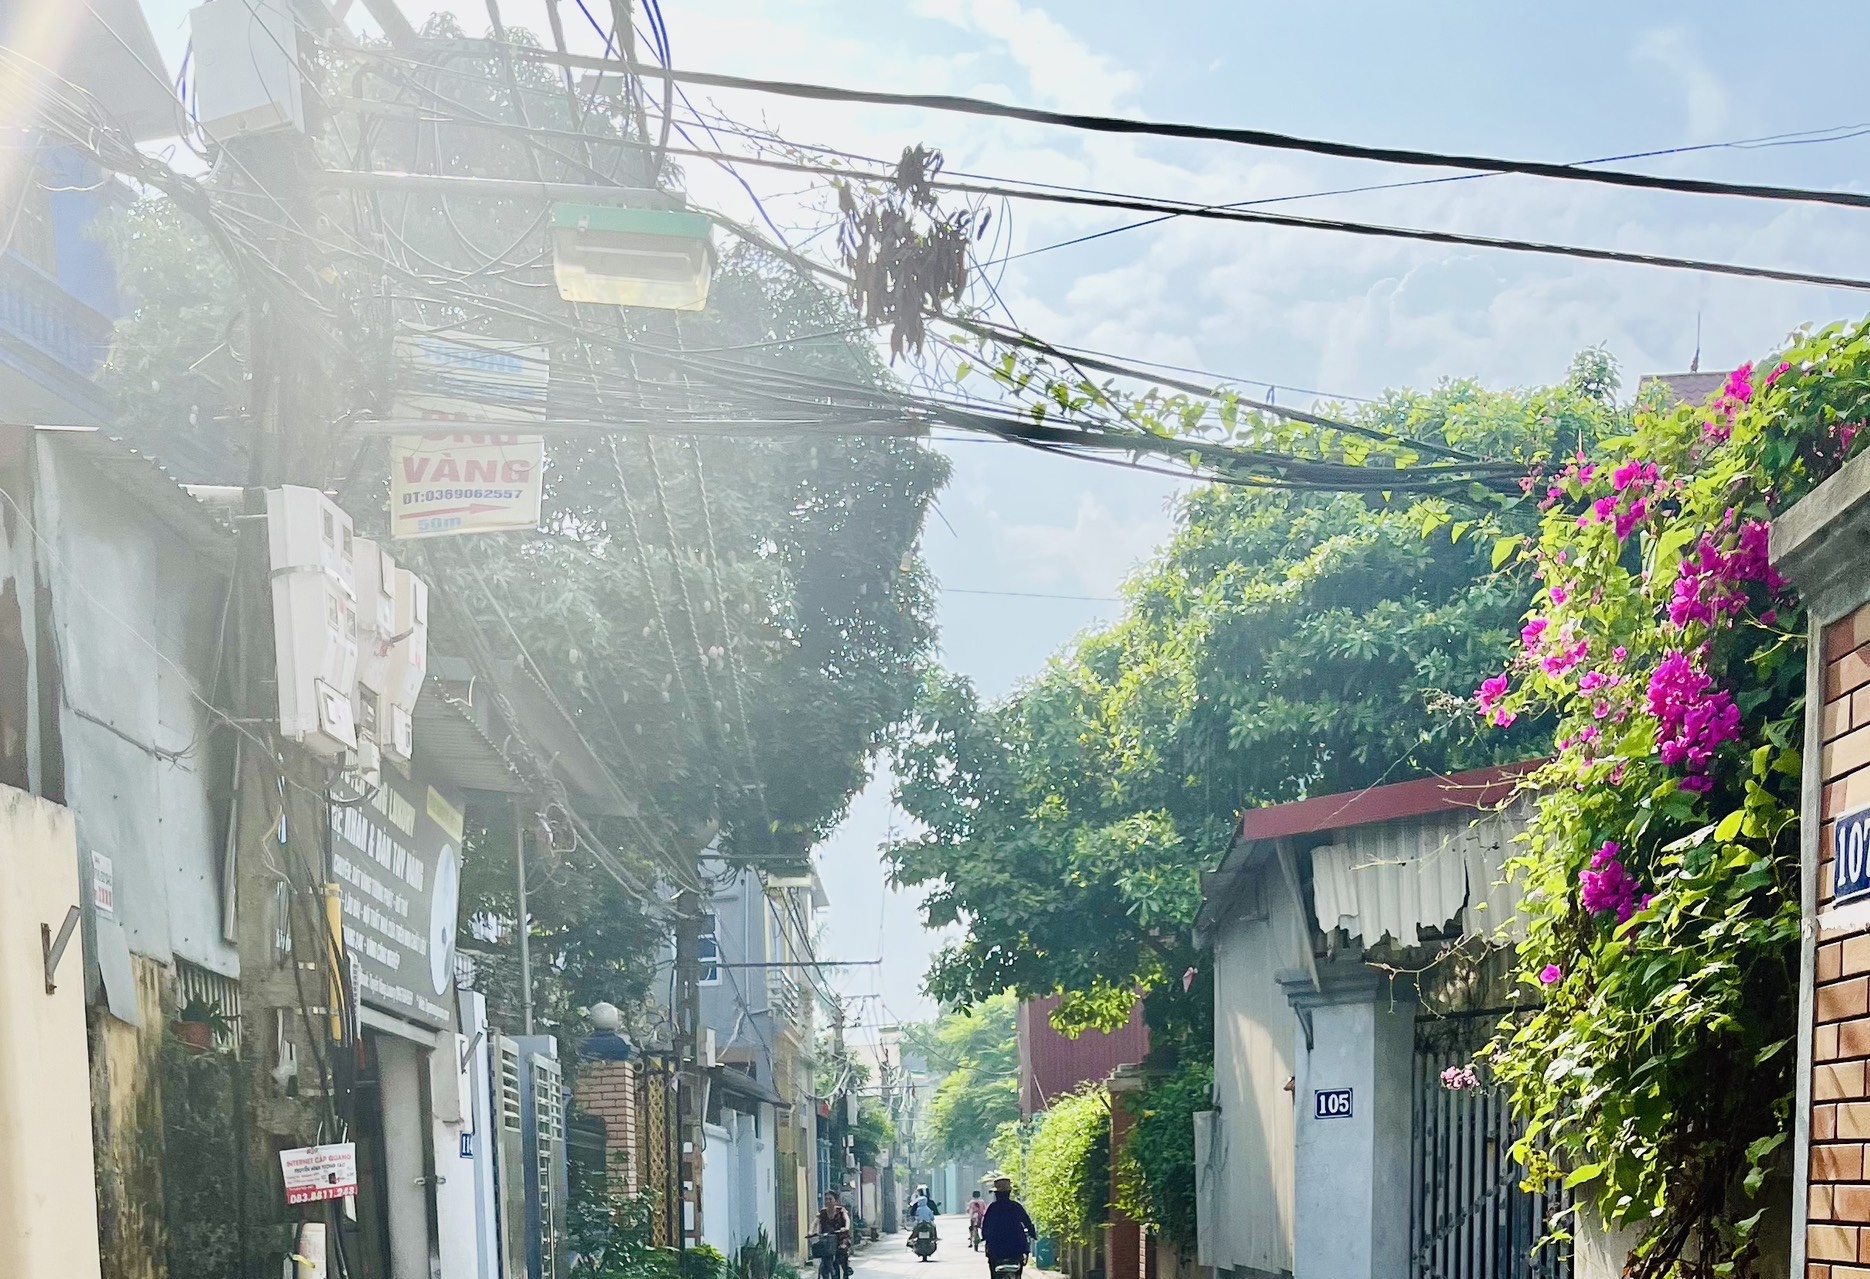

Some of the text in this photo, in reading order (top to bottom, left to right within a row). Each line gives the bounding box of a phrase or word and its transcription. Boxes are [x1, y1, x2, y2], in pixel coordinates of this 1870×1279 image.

[403, 452, 530, 484] VÀNG
[417, 517, 462, 531] 50m
[1319, 1093, 1349, 1114] 105
[286, 1158, 313, 1168] INTERNET
